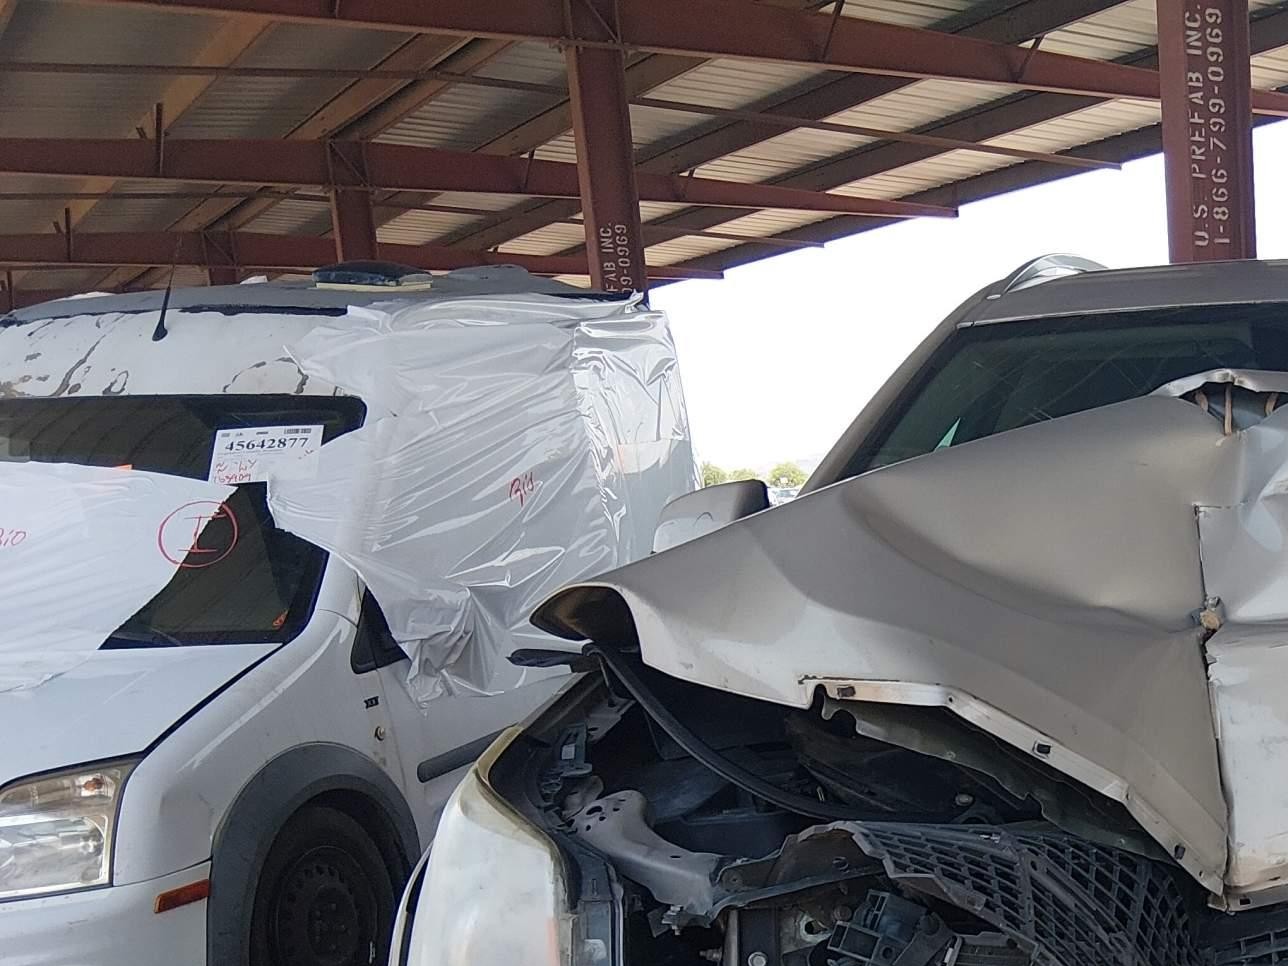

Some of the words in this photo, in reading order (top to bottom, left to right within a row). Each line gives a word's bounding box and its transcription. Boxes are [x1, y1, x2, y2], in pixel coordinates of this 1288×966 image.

[1184, 4, 1202, 55] INC.
[1187, 71, 1207, 178] PREFAB
[1205, 8, 1230, 244] 1-866-799-0969
[600, 222, 614, 253] INC.
[1193, 195, 1209, 246] U.S.
[225, 437, 309, 451] 45642877
